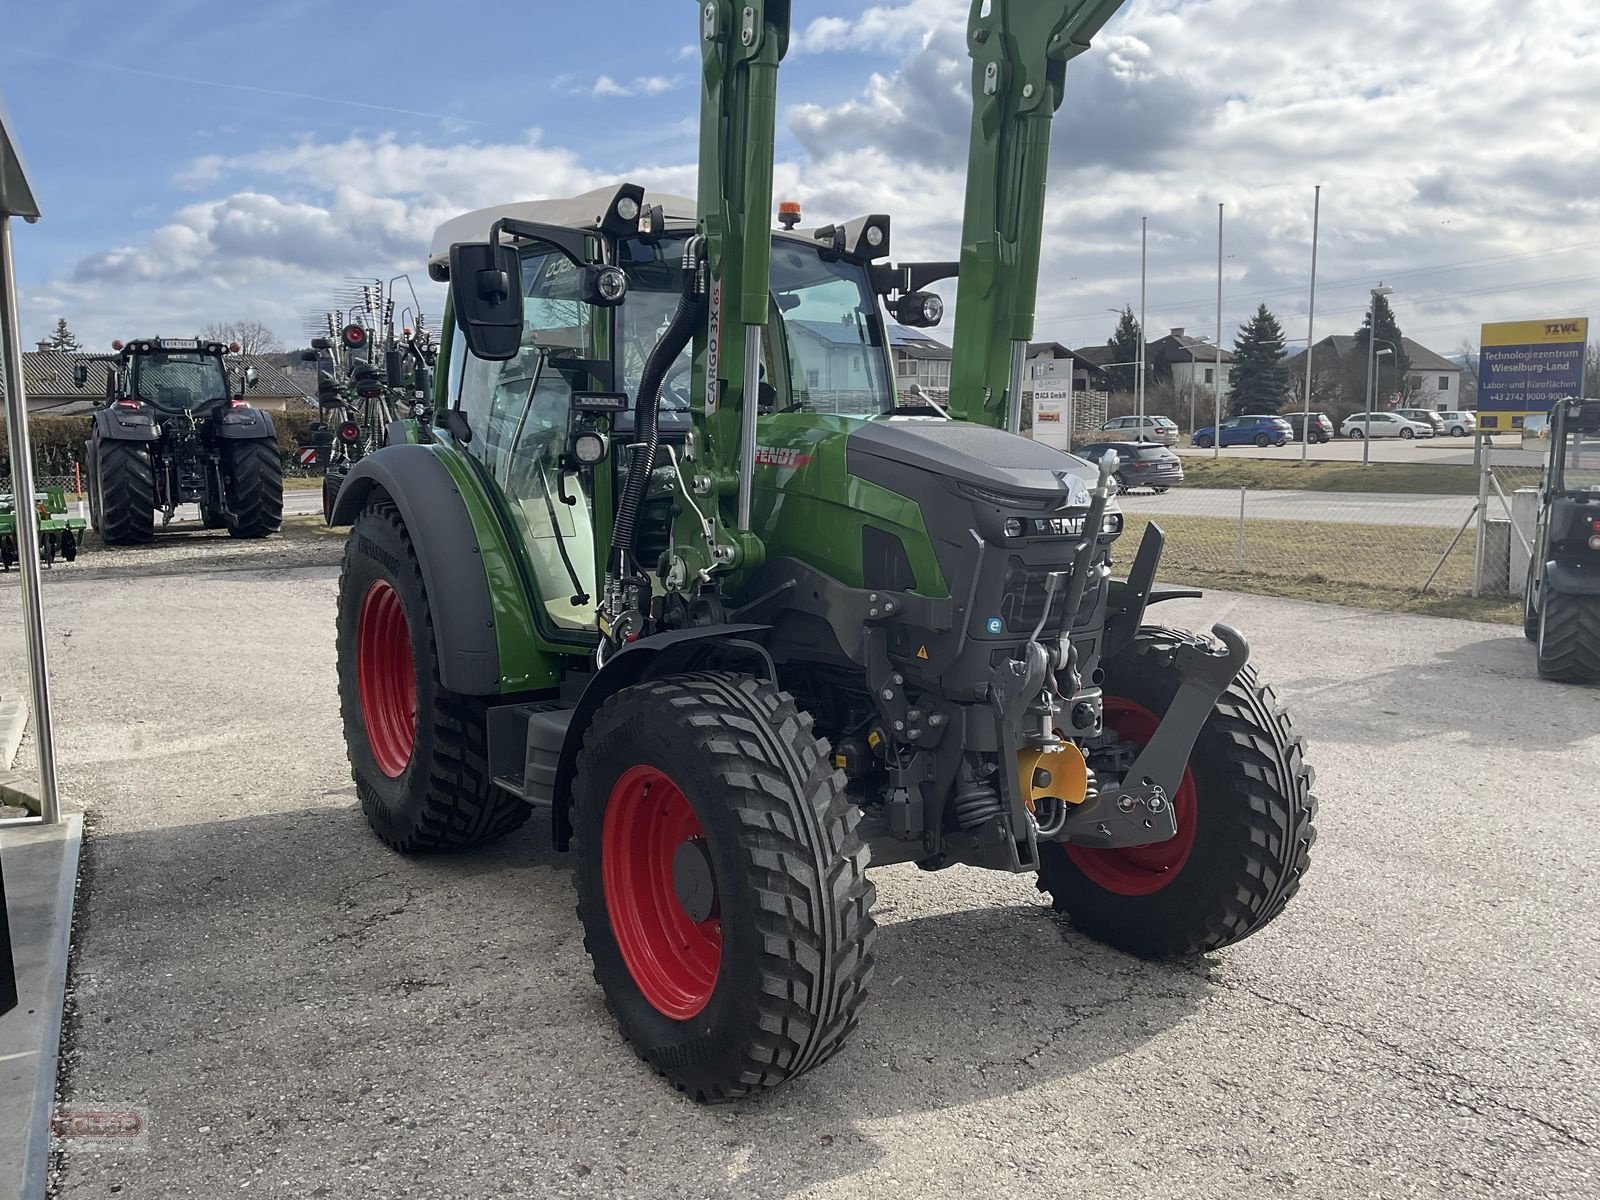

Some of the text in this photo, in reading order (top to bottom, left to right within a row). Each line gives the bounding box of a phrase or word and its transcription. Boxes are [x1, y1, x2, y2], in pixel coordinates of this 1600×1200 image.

[707, 288, 720, 405] CARGO 3X 65
[1485, 350, 1578, 361] Technologiezentrum
[1491, 361, 1570, 373] Wieselburg-Land
[1483, 381, 1508, 389] Labor-
[1509, 381, 1525, 389] und
[1489, 393, 1504, 401] +43
[1505, 392, 1524, 400] 2742
[755, 446, 800, 465] FENDT
